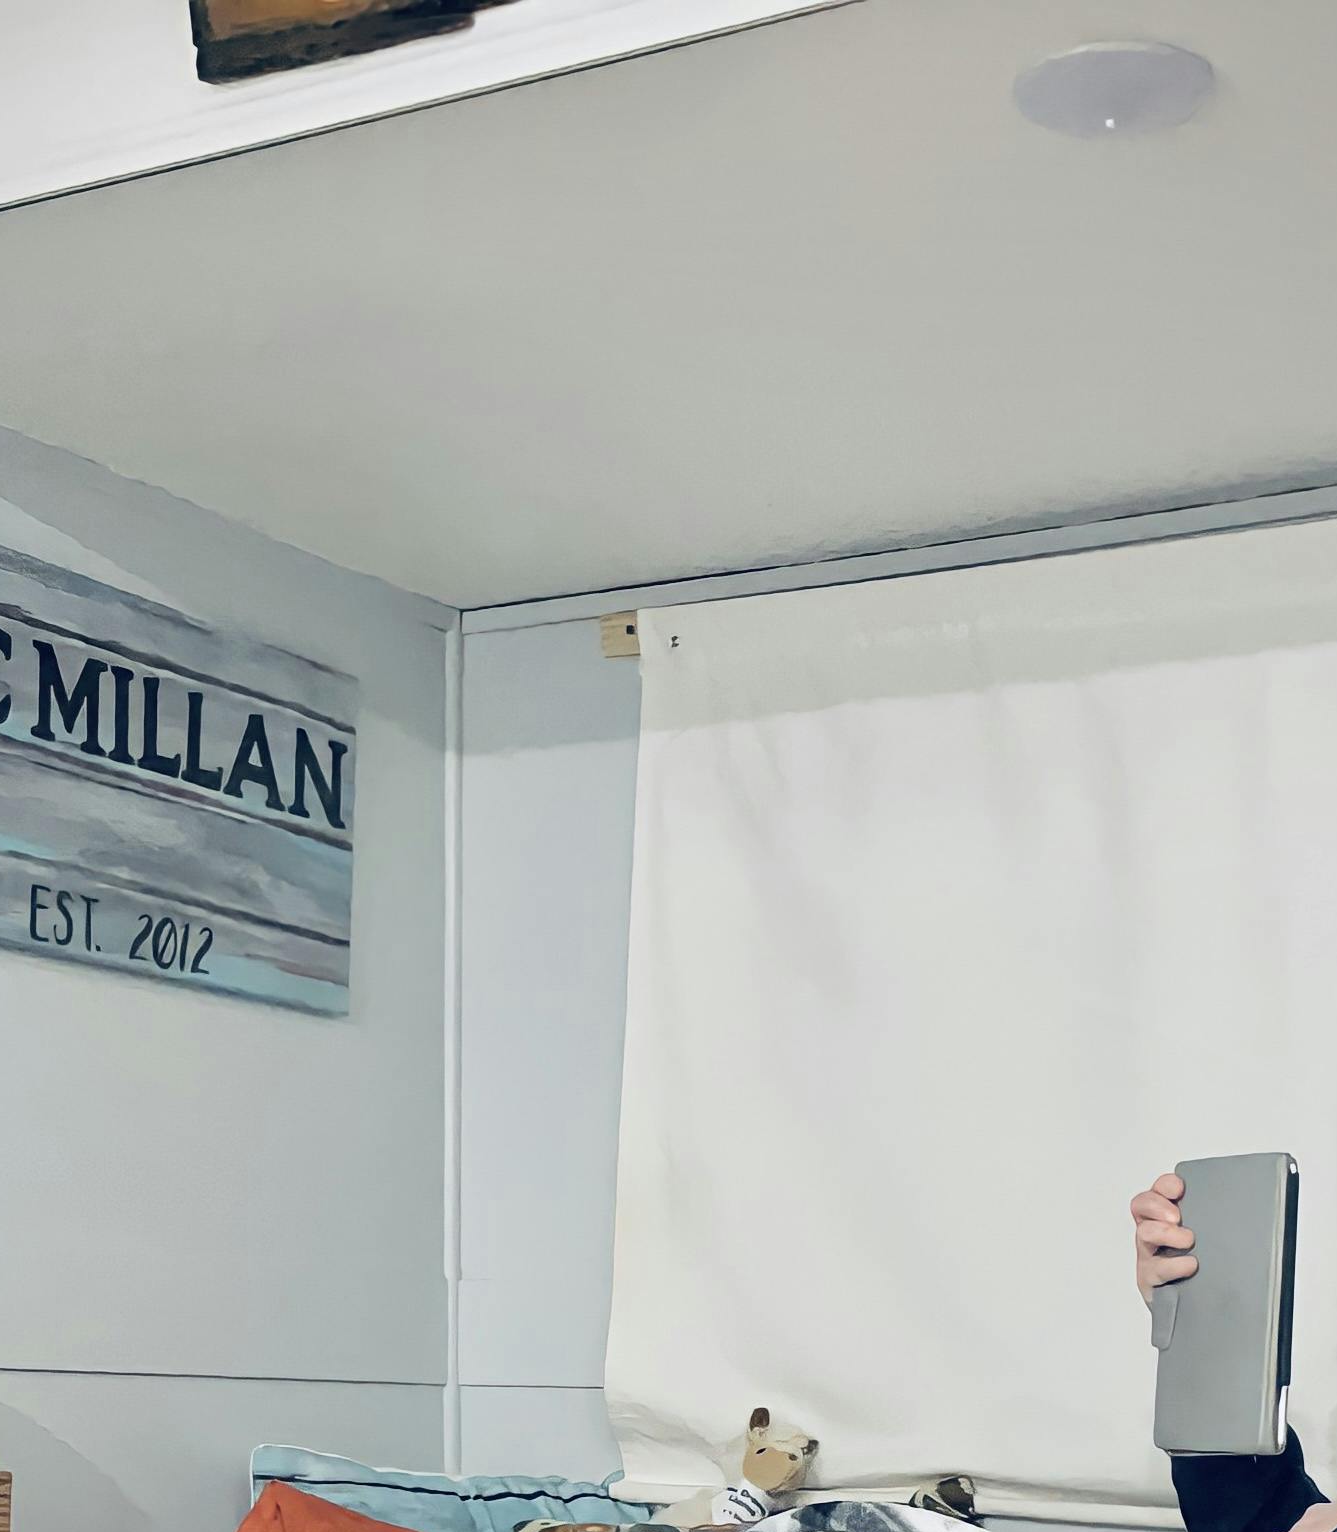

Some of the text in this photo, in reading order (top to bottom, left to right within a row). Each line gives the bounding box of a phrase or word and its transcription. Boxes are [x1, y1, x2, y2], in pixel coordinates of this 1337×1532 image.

[30, 639, 348, 830] MILLAN
[29, 884, 215, 976] EST. 2012
